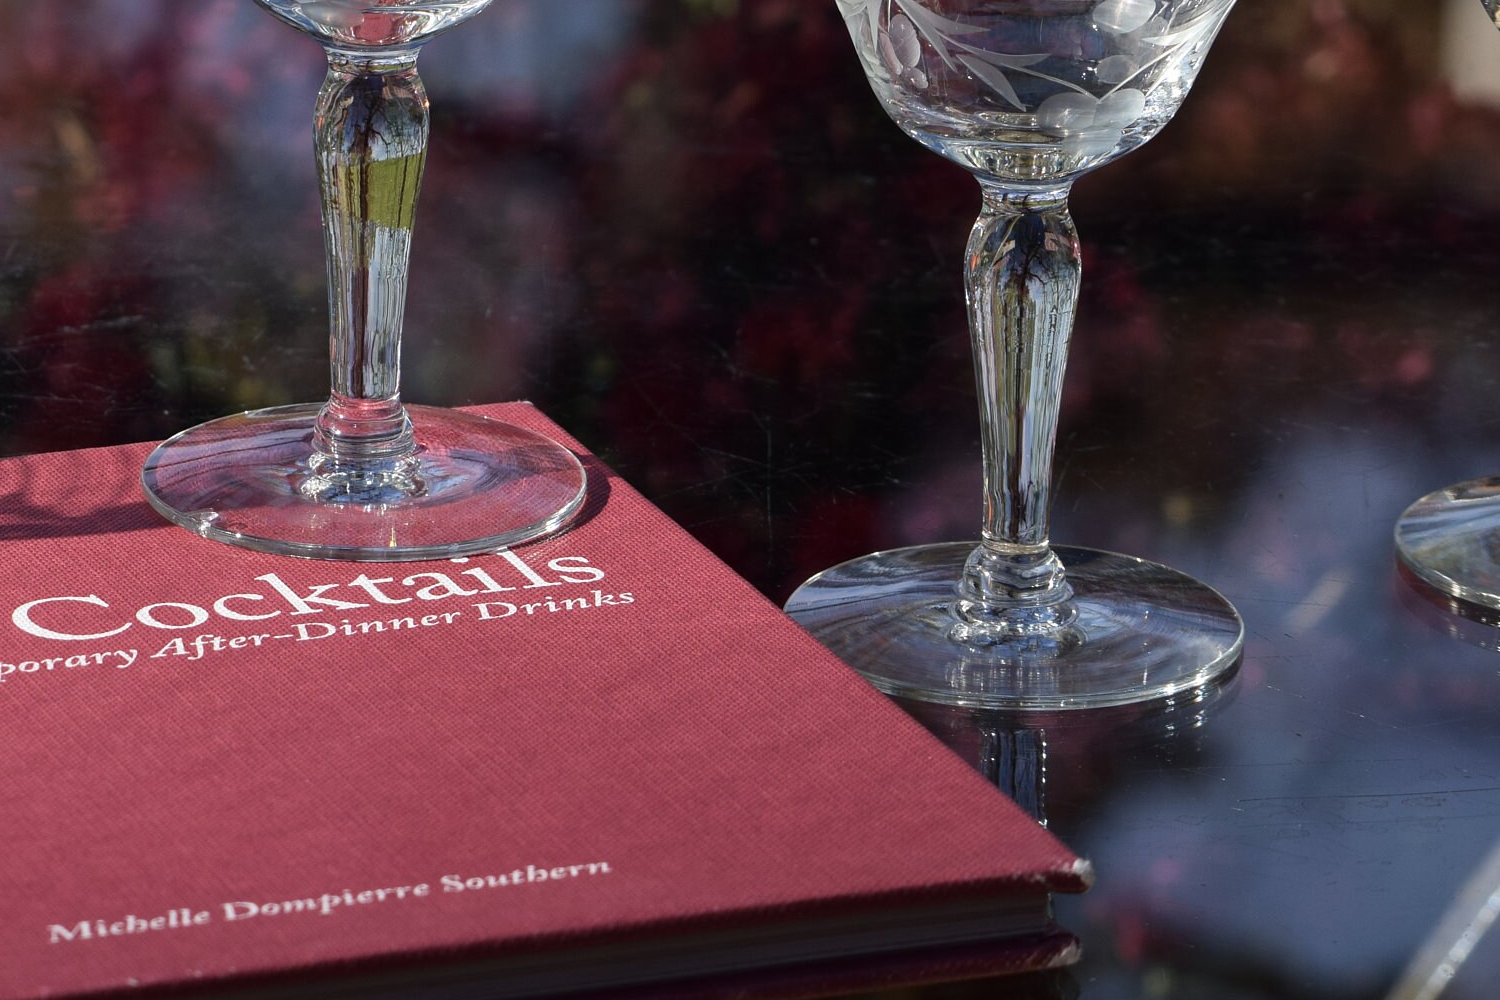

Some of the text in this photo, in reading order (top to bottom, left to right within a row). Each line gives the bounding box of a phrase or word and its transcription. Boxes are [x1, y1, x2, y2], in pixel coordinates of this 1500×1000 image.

[11, 546, 606, 641] Cocktails
[149, 610, 462, 661] After-Dinner
[470, 589, 635, 621] Drinks
[48, 860, 612, 943] Michelle Dompierre Southern
